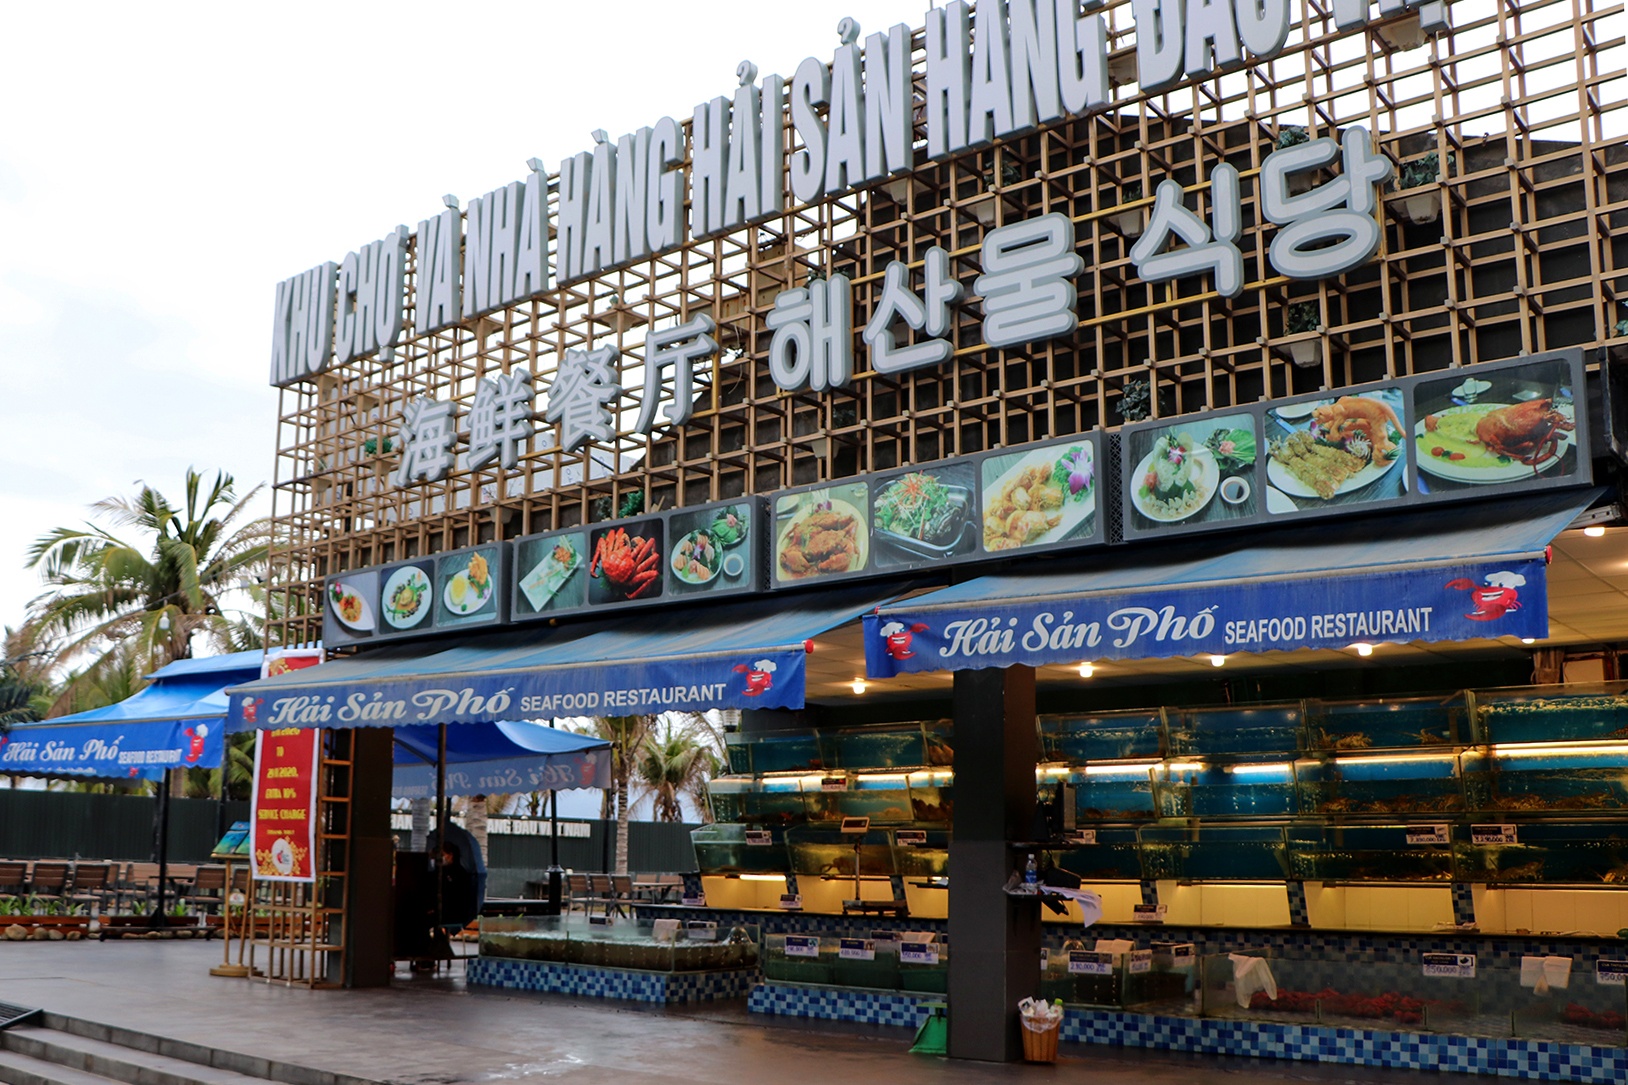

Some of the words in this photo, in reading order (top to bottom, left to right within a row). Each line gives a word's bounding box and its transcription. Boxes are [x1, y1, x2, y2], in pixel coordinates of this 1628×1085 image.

[270, 260, 338, 387] KHU
[336, 225, 410, 364] CHỢ
[415, 193, 461, 337] VÀ
[463, 157, 549, 320] NHÀ
[556, 116, 685, 286] HÀNG
[692, 60, 784, 240] HẢI
[790, 16, 913, 204] SẢN
[766, 212, 1085, 392] 해산물
[1129, 124, 1395, 298] 식당
[396, 311, 720, 487] 海鲜餐厅
[939, 616, 1018, 657] Hải
[1022, 611, 1102, 650] Sản
[1107, 604, 1220, 648] Phố
[1224, 616, 1306, 645] SEAFOOD
[1311, 607, 1433, 639] RESTAURANT
[2, 741, 37, 762] Hải
[43, 740, 76, 761] Sản
[78, 735, 125, 760] Phố
[267, 695, 334, 723] Hải
[337, 691, 407, 722] Sản
[411, 687, 515, 720] Phố
[520, 692, 599, 712] SEAFOOD
[603, 683, 727, 707] RESTAURANT
